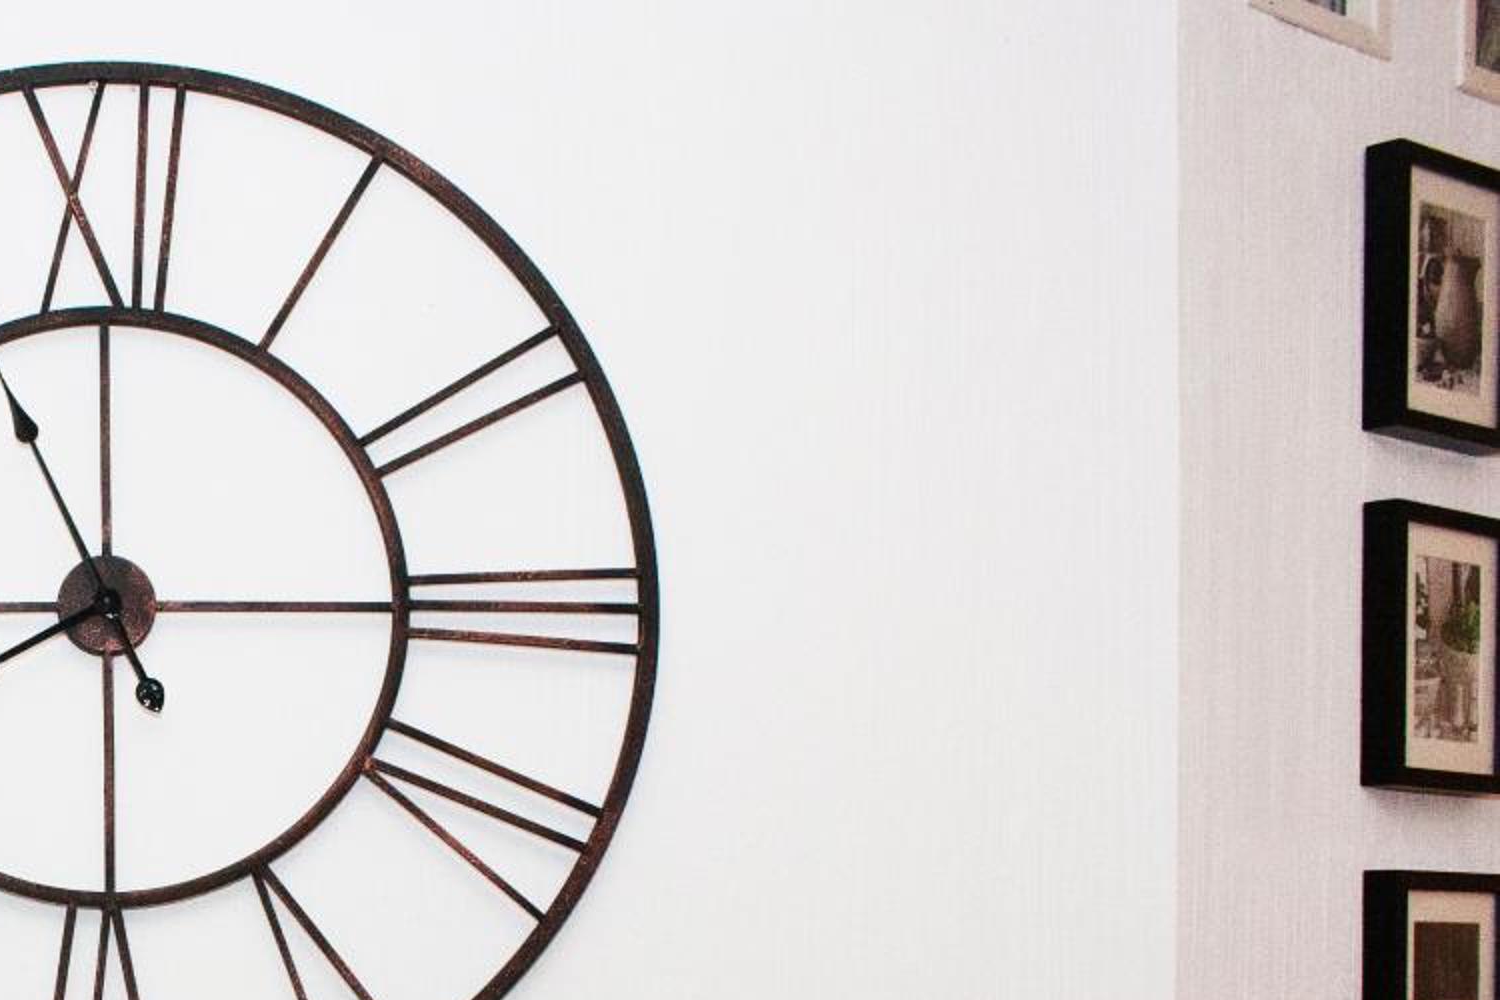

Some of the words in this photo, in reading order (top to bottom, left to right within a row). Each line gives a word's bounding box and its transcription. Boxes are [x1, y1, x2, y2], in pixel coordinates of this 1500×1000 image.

[23, 80, 187, 314] XII
[256, 154, 386, 351] I
[355, 325, 590, 477] II
[407, 567, 642, 657] III
[364, 717, 604, 923] IV
